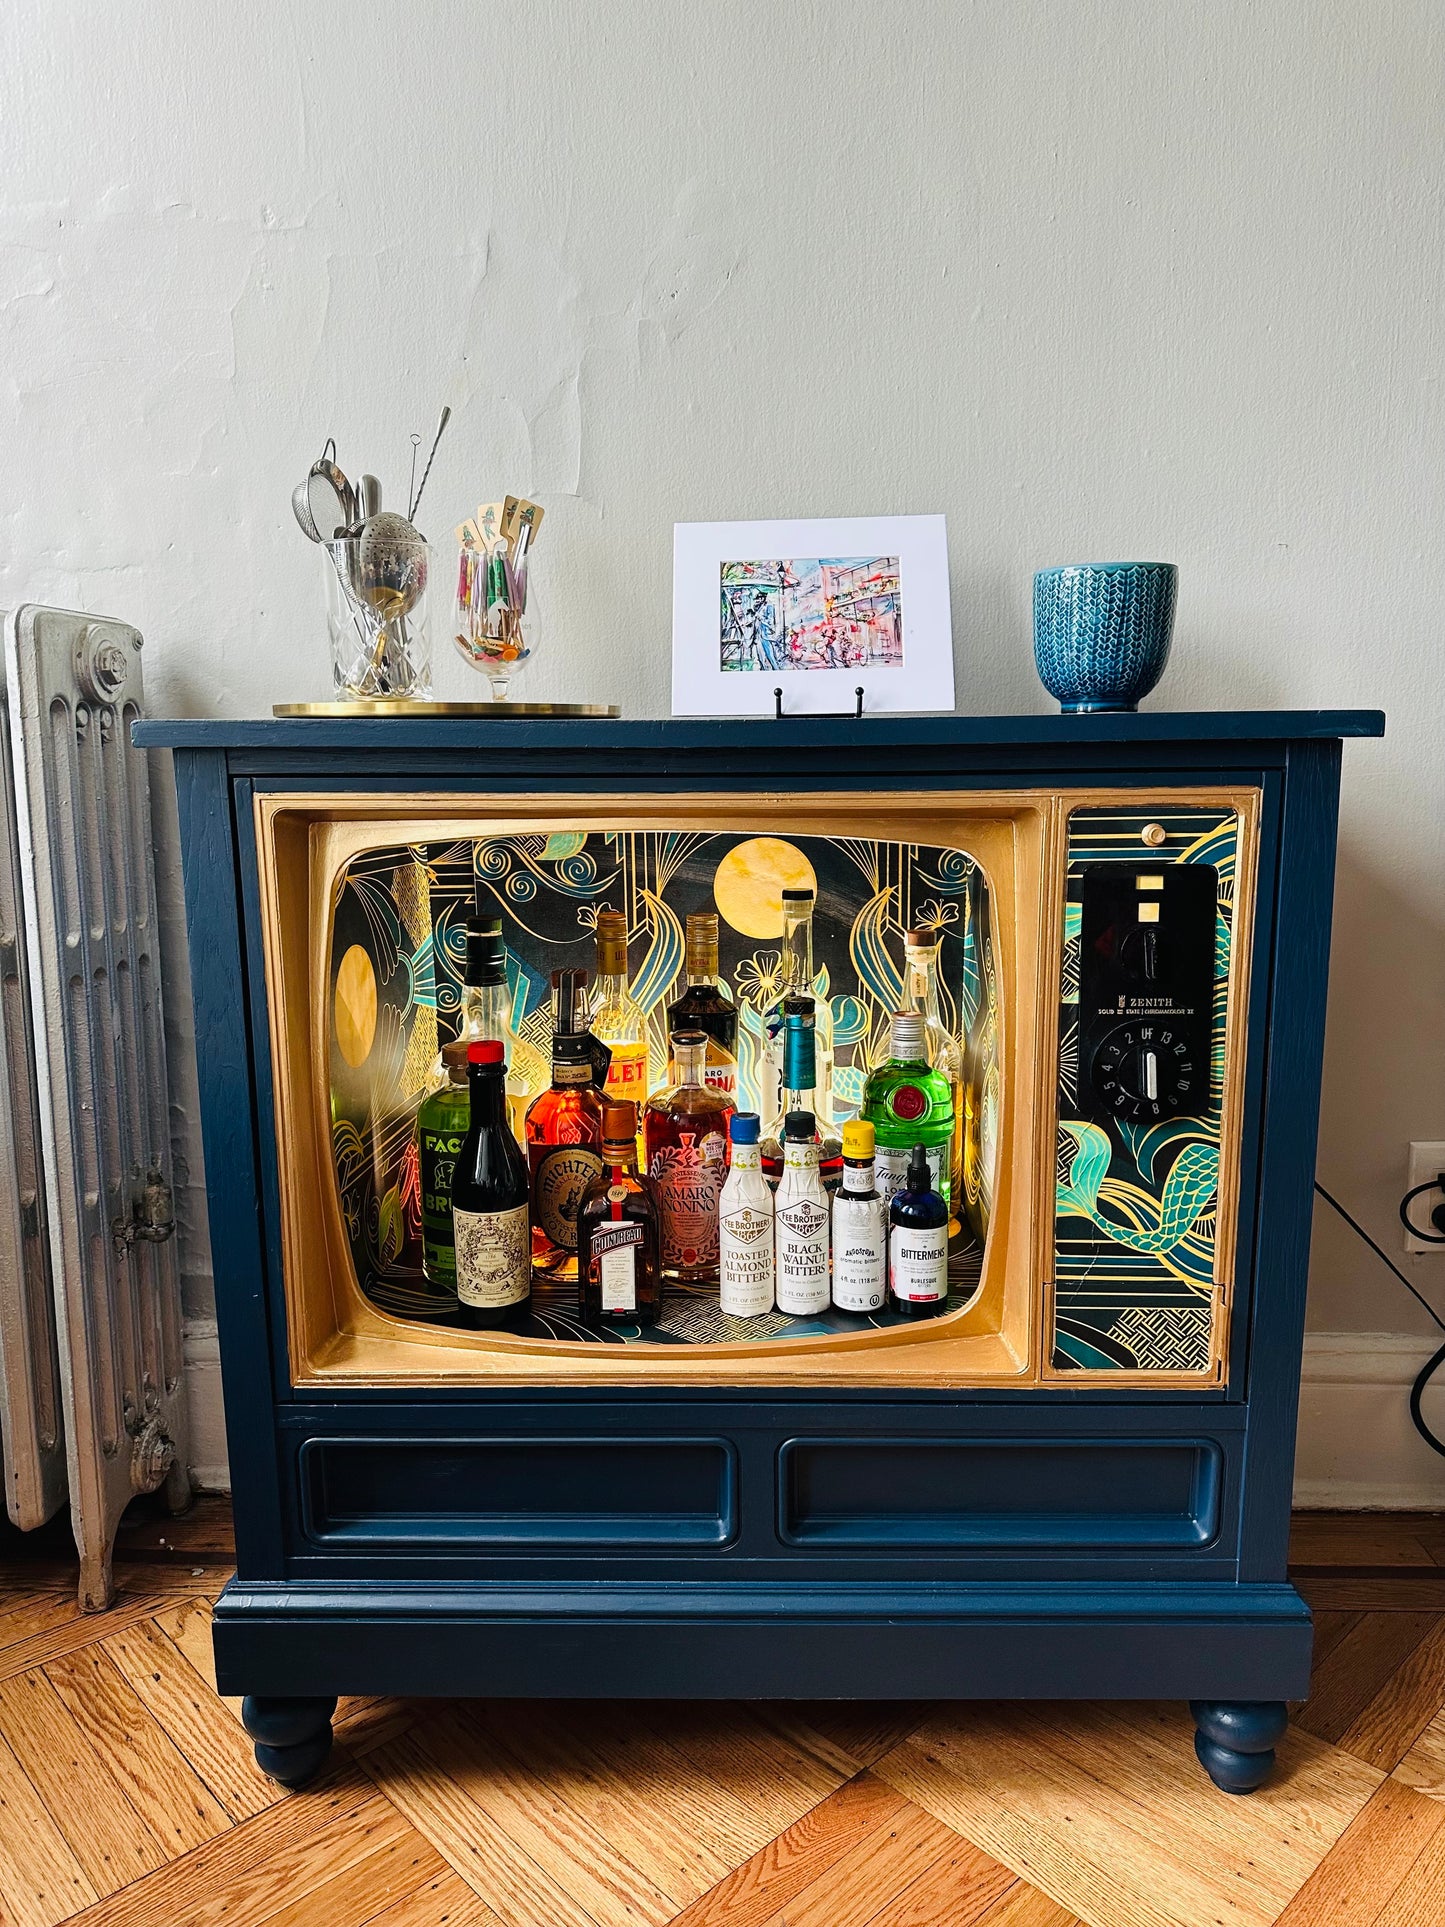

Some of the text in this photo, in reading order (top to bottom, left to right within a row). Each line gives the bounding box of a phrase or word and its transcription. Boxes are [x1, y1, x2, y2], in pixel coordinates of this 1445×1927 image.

[1130, 998, 1173, 1007] ZENITH
[1124, 1033, 1134, 1044] 2
[1160, 1031, 1173, 1044] 13
[1109, 1046, 1121, 1056] 3
[1173, 1043, 1187, 1056] 12
[1101, 1063, 1114, 1072] 4
[1180, 1062, 1193, 1072] 11
[1103, 1081, 1116, 1090] 5
[1177, 1079, 1191, 1091] 10
[1114, 1095, 1125, 1106] 6
[1168, 1095, 1178, 1105] 9
[1132, 1103, 1140, 1115] 7
[1151, 1102, 1160, 1114] 8
[663, 1186, 714, 1199] AMARO
[663, 1199, 715, 1213] NONINO
[781, 1212, 793, 1222] FEE
[724, 1218, 735, 1229] FEE
[592, 1227, 643, 1256] COINTREAU
[726, 1248, 769, 1261] TOASTED
[787, 1242, 823, 1255] BLACK
[845, 1247, 875, 1257] ANGOSTURA
[900, 1246, 945, 1261] BITTERMENS
[723, 1257, 772, 1272] ALMOND
[782, 1252, 827, 1266] WALNUT
[726, 1269, 770, 1283] BITTERS
[784, 1263, 826, 1277] BITTERS
